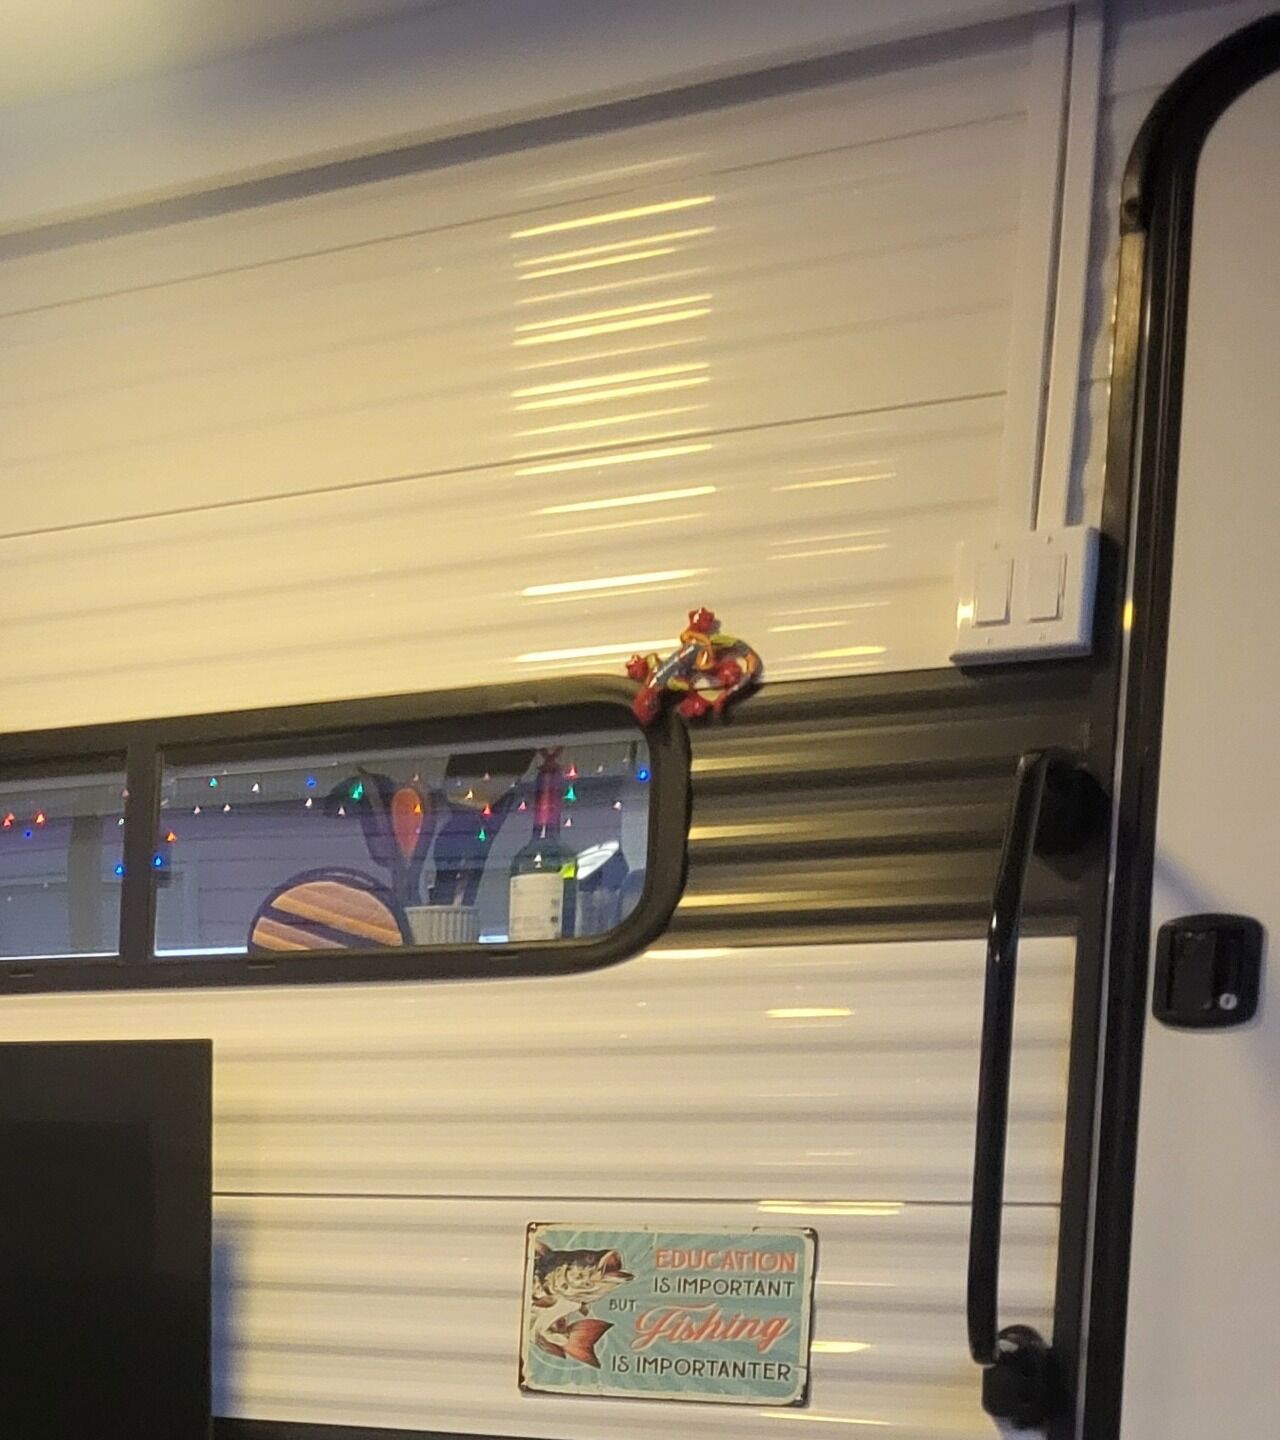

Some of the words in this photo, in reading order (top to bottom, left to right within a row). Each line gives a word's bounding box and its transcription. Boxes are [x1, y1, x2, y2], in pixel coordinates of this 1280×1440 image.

[654, 1248, 796, 1273] EDUCATION
[653, 1277, 671, 1293] IS
[677, 1278, 796, 1297] IMPORTANT
[609, 1298, 637, 1312] BUT
[631, 1303, 792, 1354] Fishing
[611, 1354, 630, 1372] IS
[636, 1356, 792, 1381] IMPORTANTER
